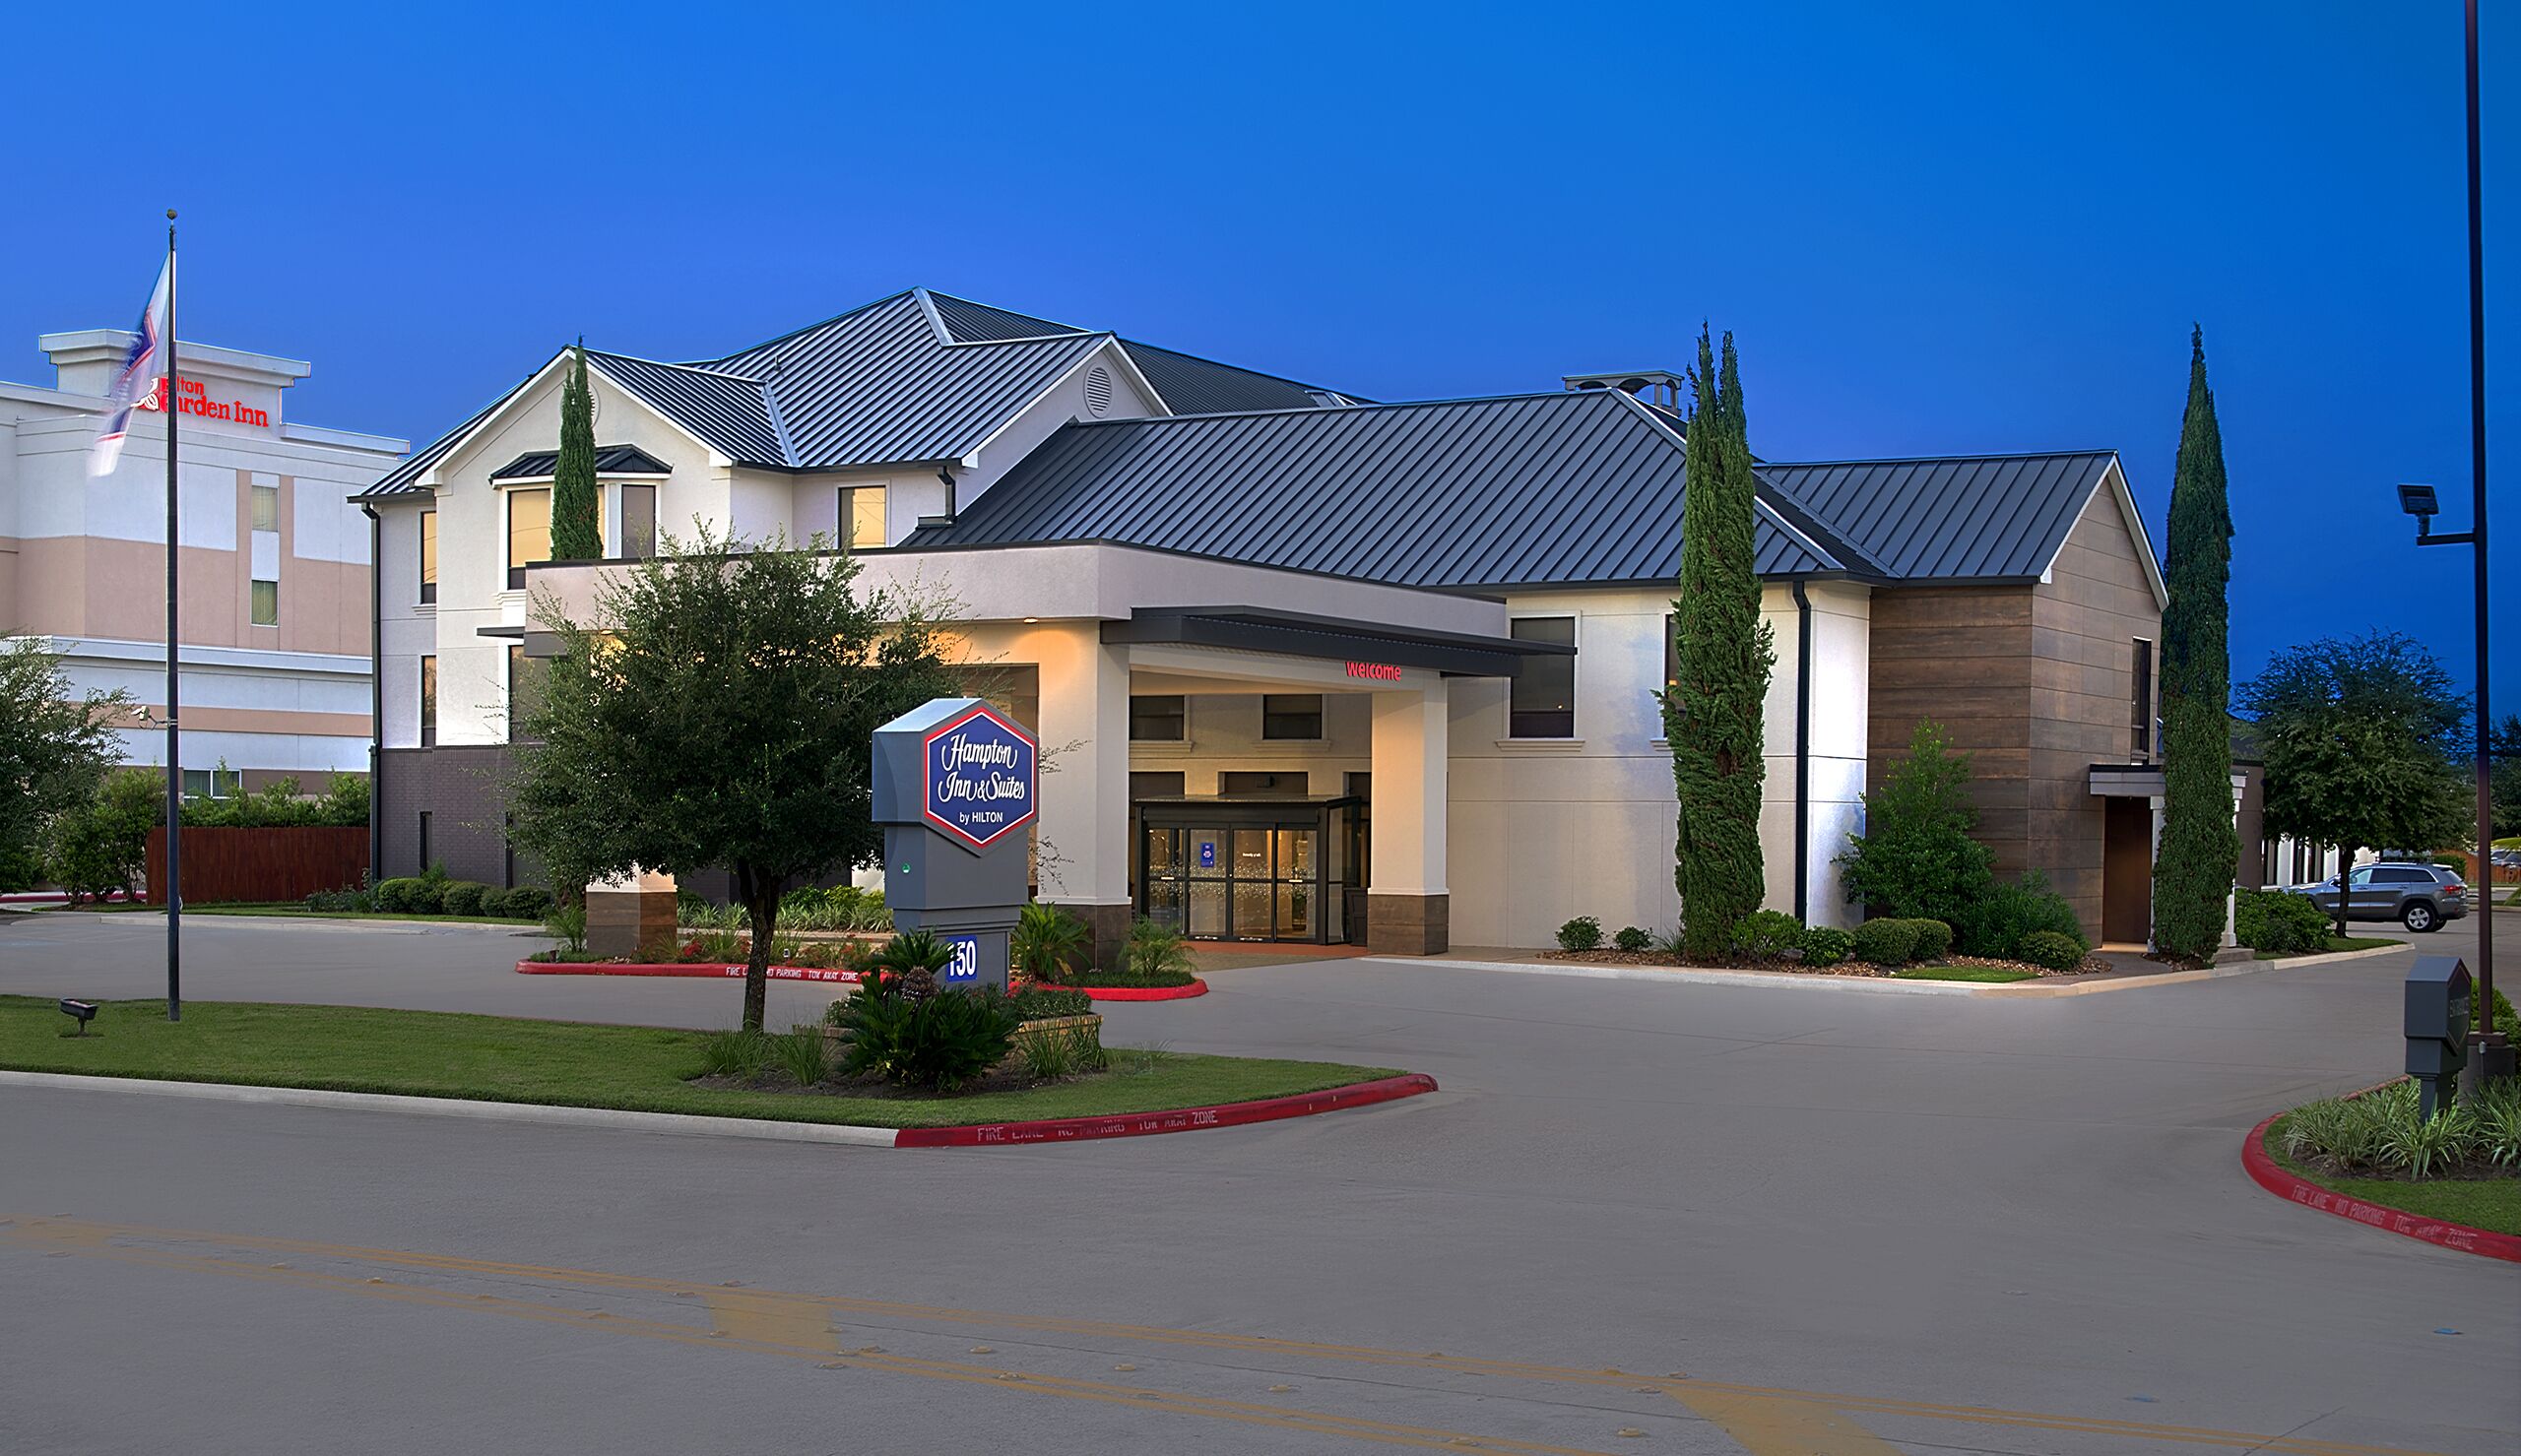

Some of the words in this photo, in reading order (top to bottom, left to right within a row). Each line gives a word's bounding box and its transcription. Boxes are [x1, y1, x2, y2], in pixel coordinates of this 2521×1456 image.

[233, 400, 269, 427] Inn
[1346, 661, 1401, 681] welcome
[941, 733, 1017, 771] Hampton
[937, 771, 978, 802] Inn
[977, 780, 988, 801] &
[986, 771, 1025, 800] Suites
[959, 811, 970, 825] by
[972, 811, 1002, 823] HILTON
[726, 967, 740, 976] FIRE
[776, 969, 802, 979] PARKING
[808, 971, 820, 980] TOW
[841, 972, 859, 981] ZONE
[977, 1126, 1005, 1142] FIRE
[1192, 1109, 1218, 1124] ZONE
[2292, 1184, 2309, 1203] FIRE
[2307, 1190, 2331, 1209] LANE
[2335, 1198, 2349, 1215] NO
[2349, 1202, 2386, 1226] PARKING
[2444, 1228, 2478, 1250] ZONE
